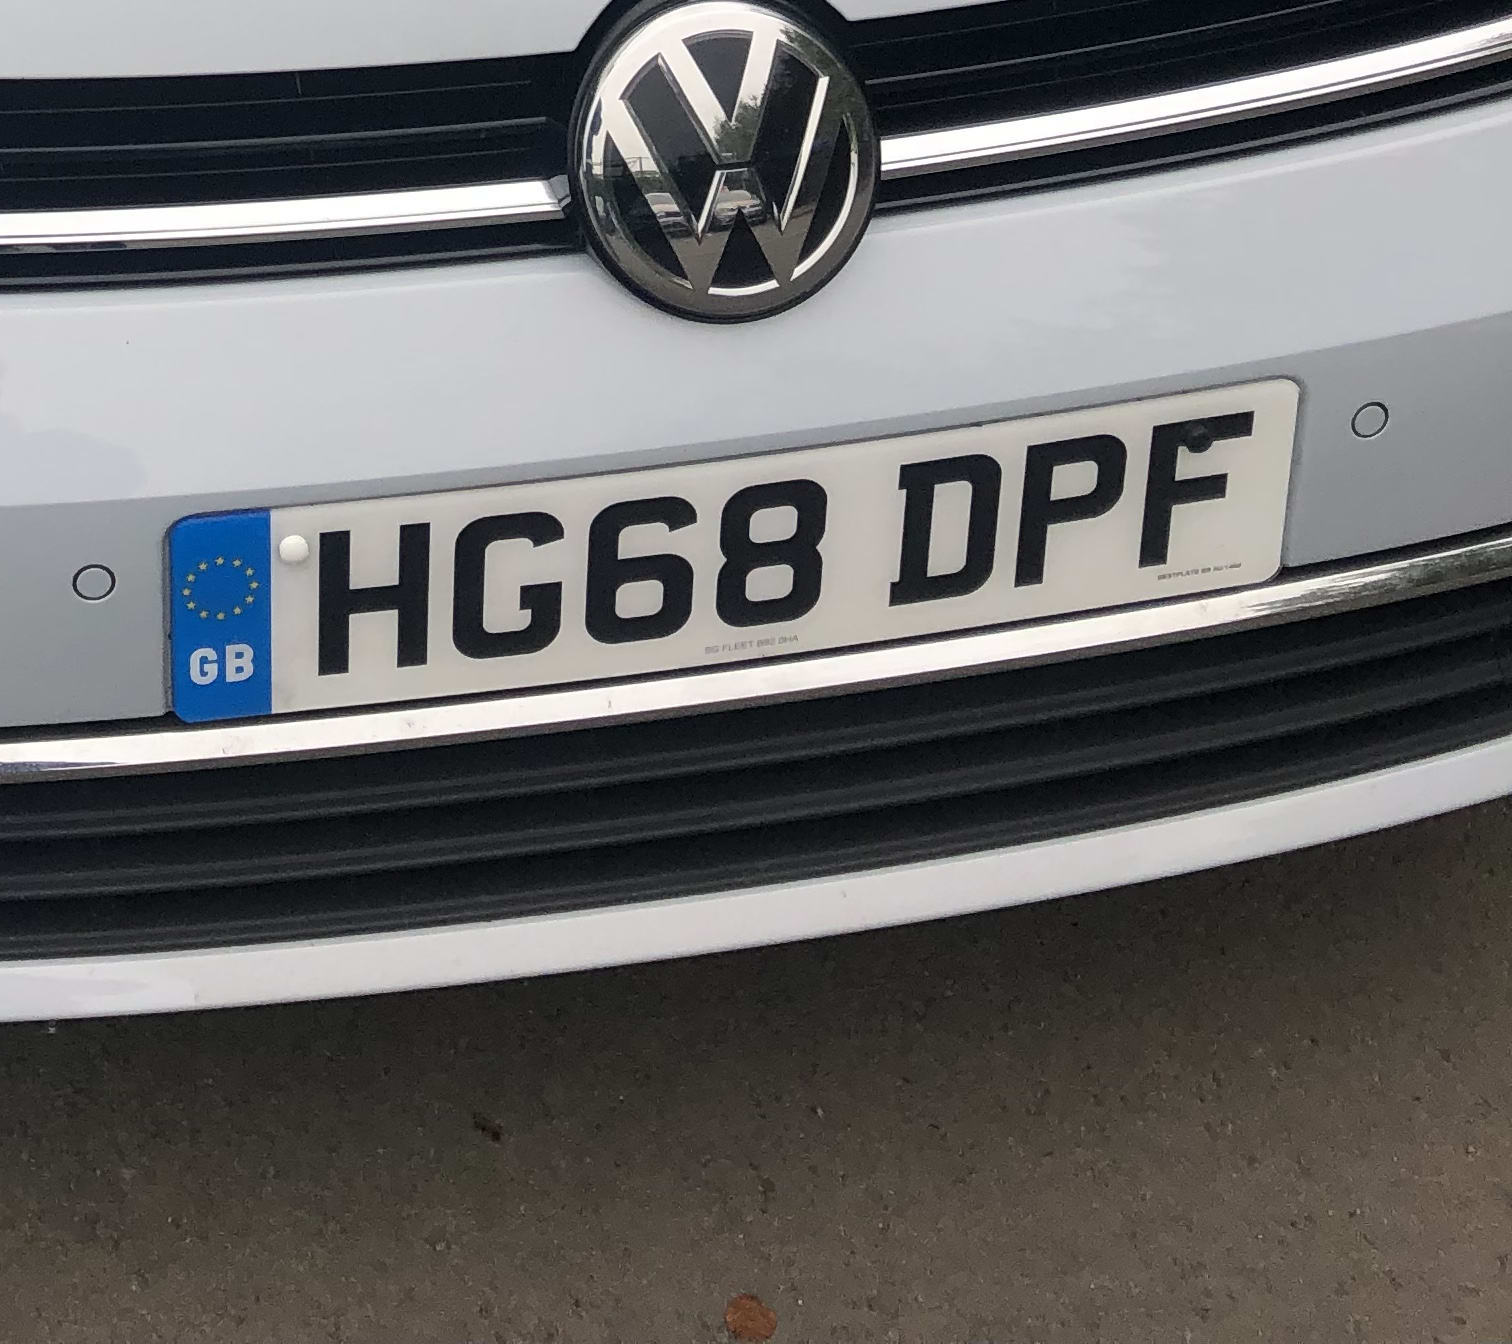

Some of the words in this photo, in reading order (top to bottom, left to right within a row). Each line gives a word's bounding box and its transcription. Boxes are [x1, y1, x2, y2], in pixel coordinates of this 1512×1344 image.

[317, 477, 829, 677] HG68
[887, 409, 1256, 608] DPF
[188, 643, 255, 688] GB
